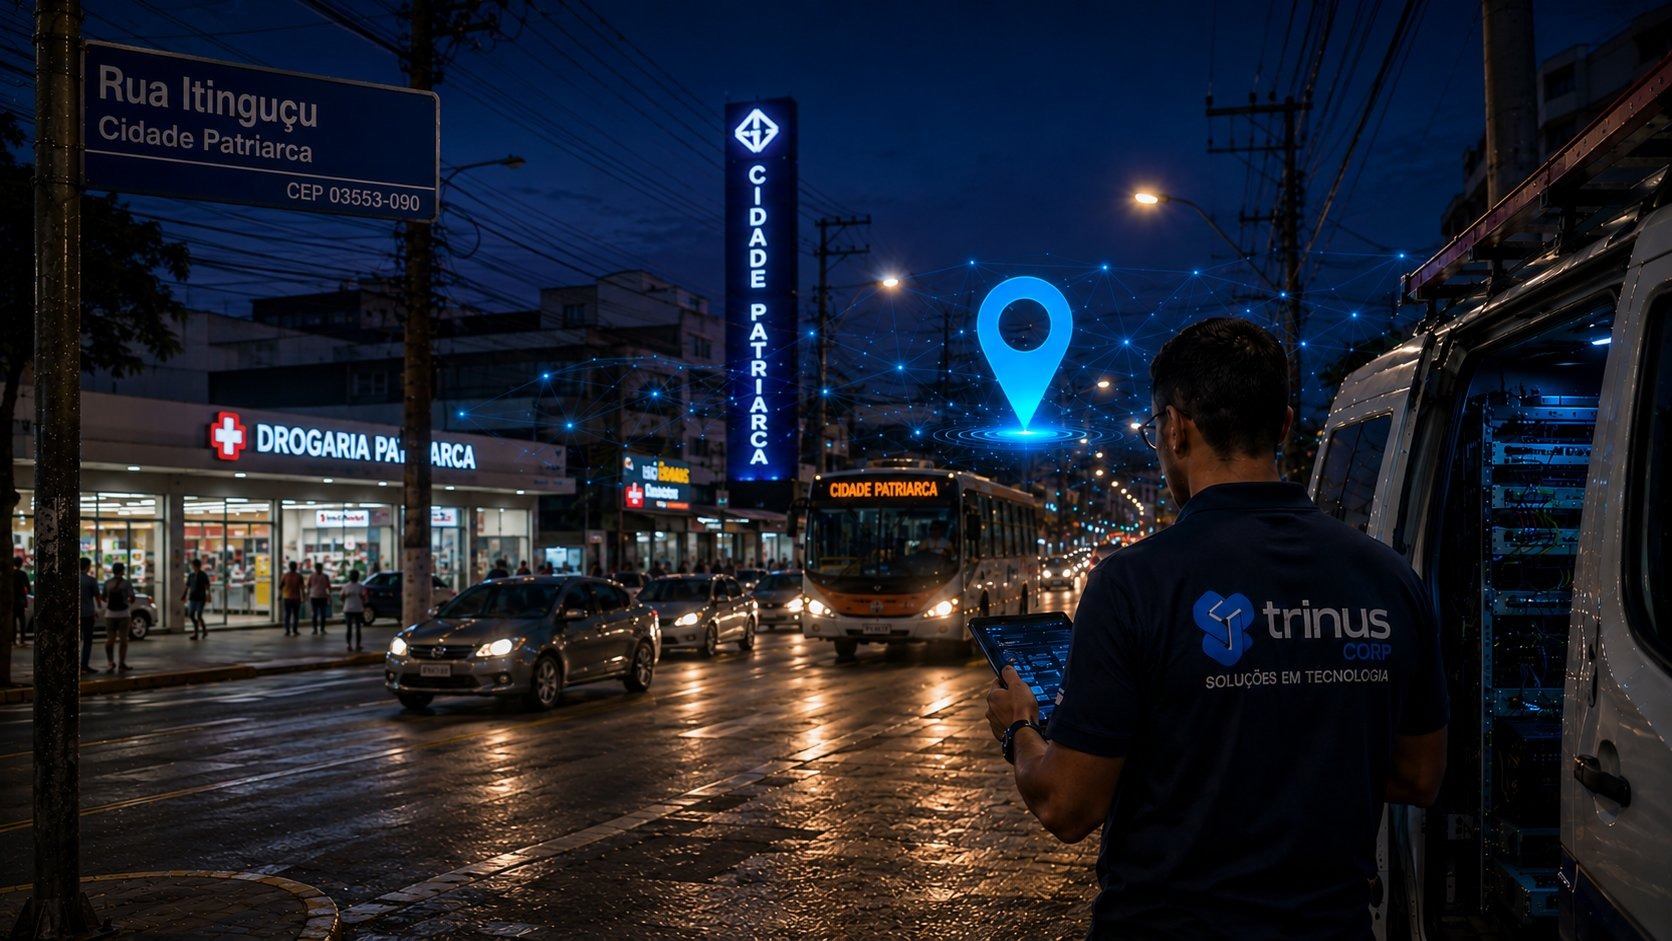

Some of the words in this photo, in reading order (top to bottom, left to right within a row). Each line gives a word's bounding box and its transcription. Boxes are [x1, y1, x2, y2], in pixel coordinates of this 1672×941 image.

[99, 64, 169, 108] Rua
[182, 76, 318, 132] Itinguçu
[98, 115, 194, 149] Cidade
[203, 128, 313, 163] Patriarca
[286, 182, 324, 201] CEP
[329, 187, 421, 212] 03553-090
[748, 165, 768, 288] CIDADE
[749, 303, 769, 465] PATRIARCA
[256, 423, 371, 462] DROGARIA
[374, 435, 477, 470] PAARCA
[829, 482, 872, 498] CIDADE
[874, 481, 939, 497] PATRIARCA
[1262, 599, 1392, 640] trinus
[1343, 642, 1392, 661] CORP
[1205, 668, 1277, 689] SOLUÇÕES
[1281, 670, 1301, 685] EM
[1304, 668, 1389, 684] TECNOLOGIA
